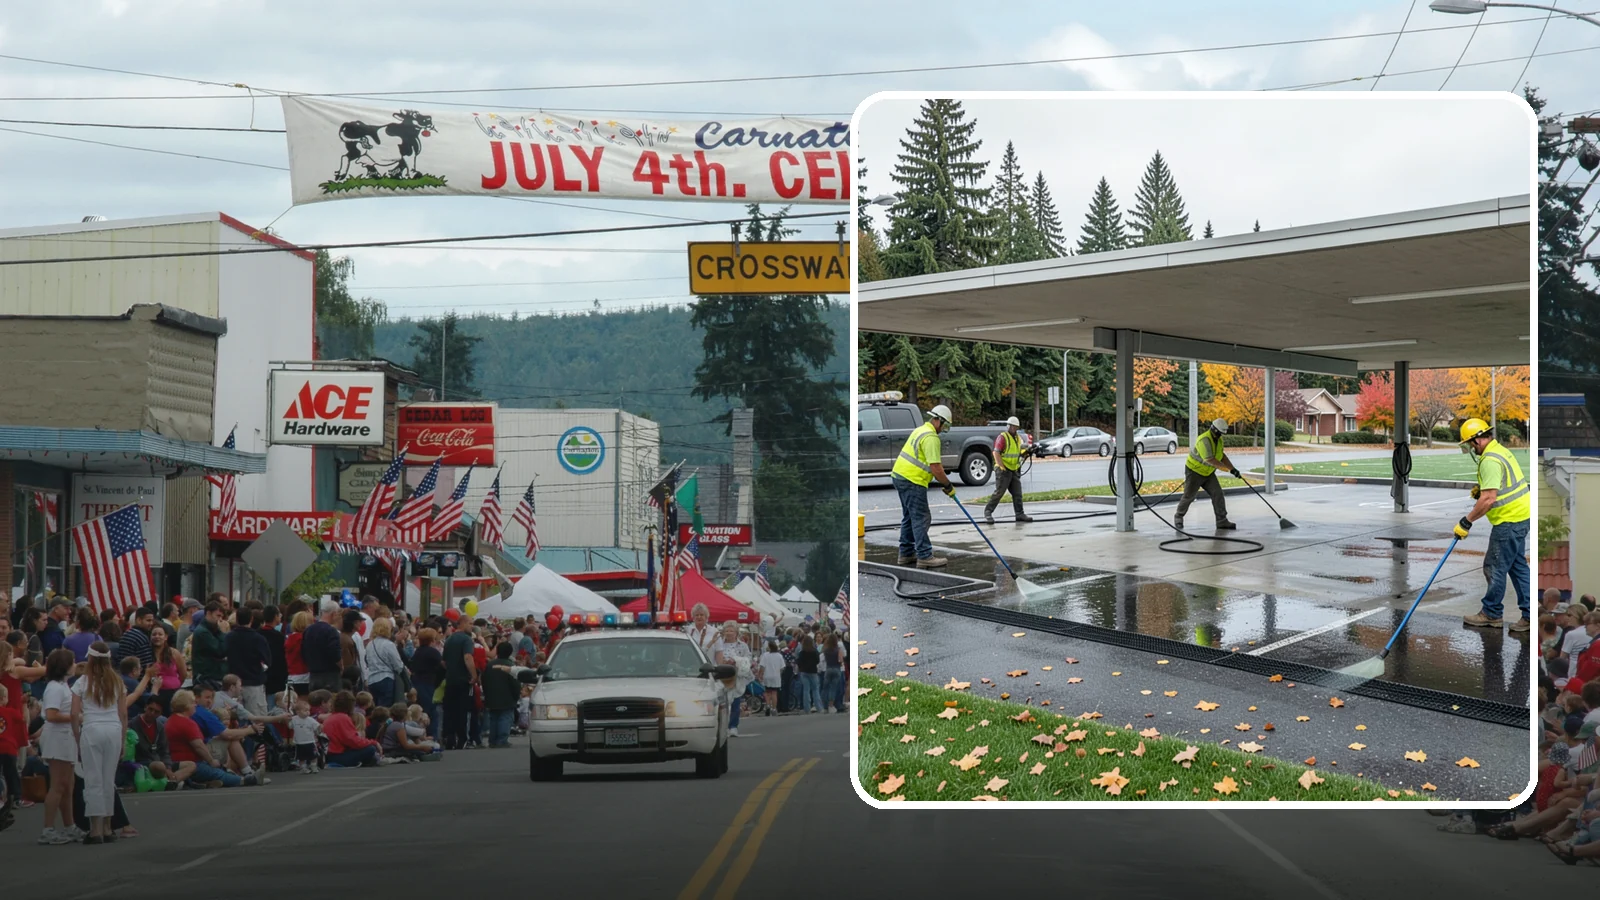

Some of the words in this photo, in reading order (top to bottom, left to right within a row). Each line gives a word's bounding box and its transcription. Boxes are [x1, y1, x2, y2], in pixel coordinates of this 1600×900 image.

[481, 141, 604, 192] JULY
[632, 150, 746, 197] 4th.
[697, 254, 850, 279] CROSSWA
[283, 380, 373, 419] ACE
[406, 409, 452, 421] CEDAR
[283, 421, 370, 436] Hardware
[416, 428, 477, 446] Coca-Cola
[354, 467, 384, 478] Simpl
[83, 485, 93, 494] St.
[95, 485, 124, 494] Vincent
[126, 486, 136, 494] de
[137, 486, 155, 495] Paul
[212, 516, 330, 535] HARDARE
[688, 527, 741, 535] CRNATION
[699, 535, 730, 543] GLASS
